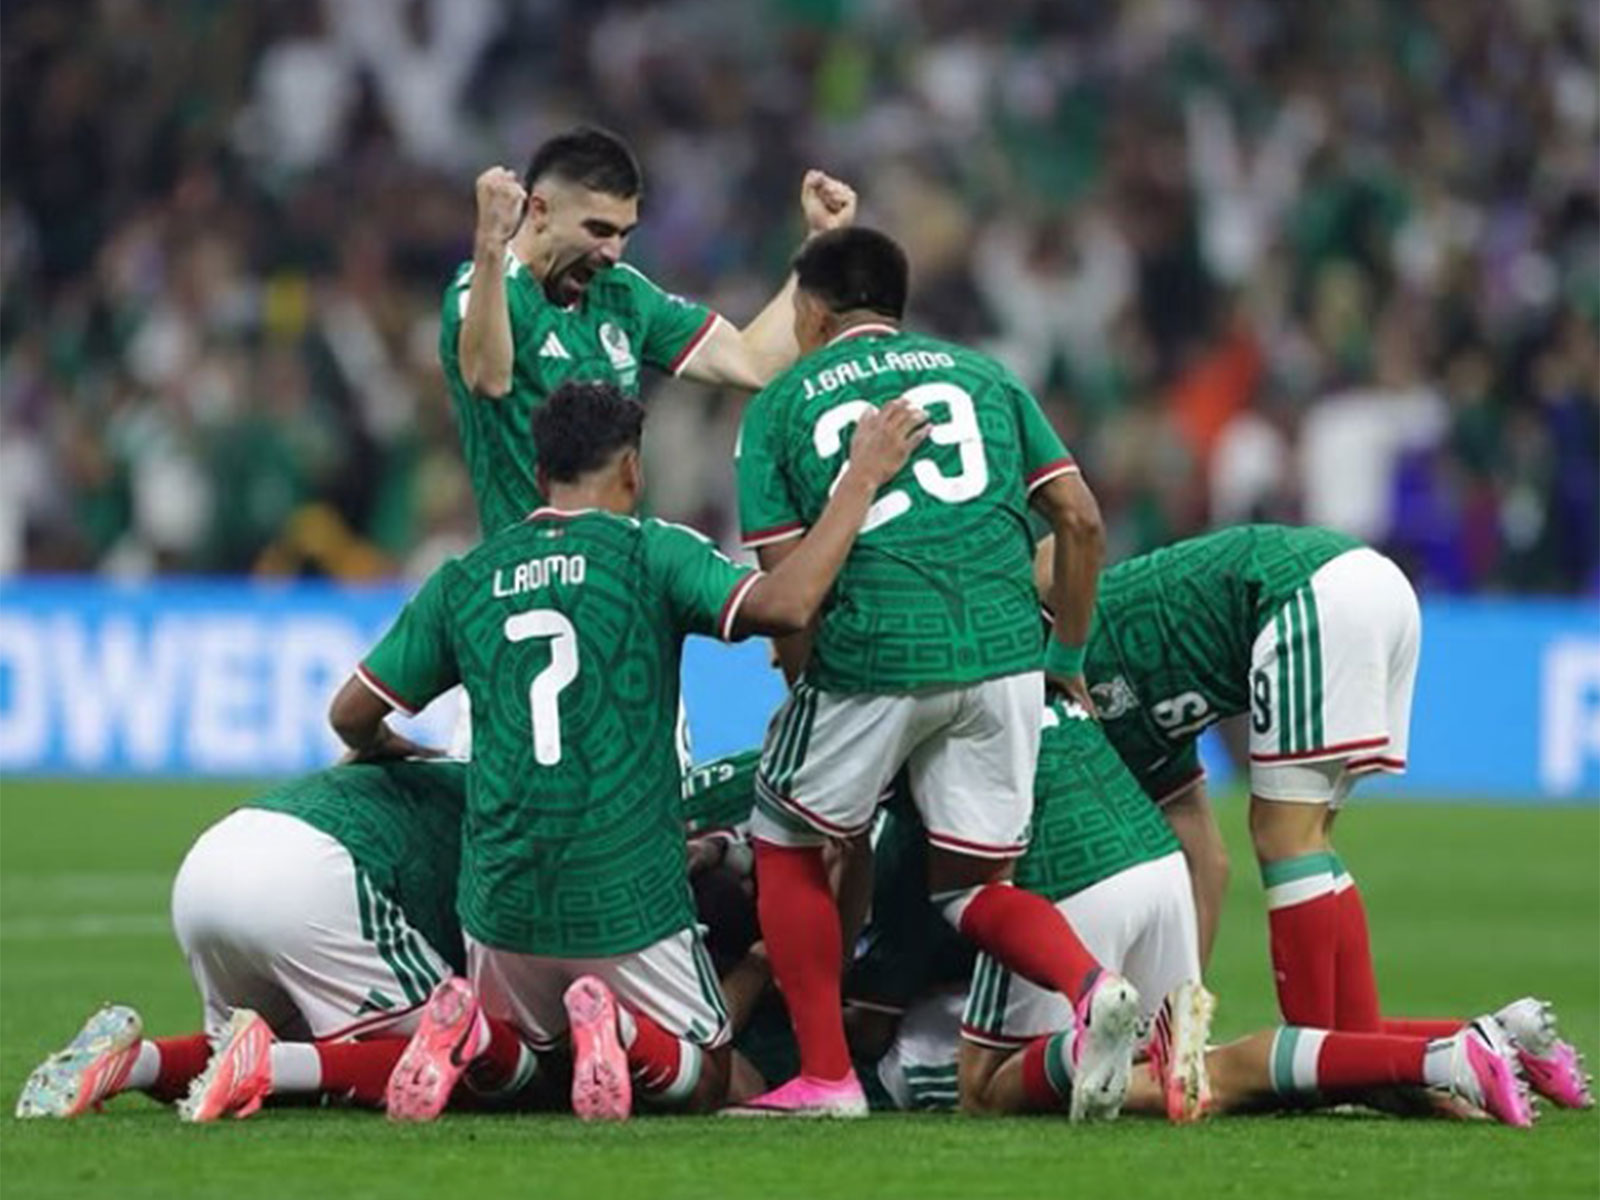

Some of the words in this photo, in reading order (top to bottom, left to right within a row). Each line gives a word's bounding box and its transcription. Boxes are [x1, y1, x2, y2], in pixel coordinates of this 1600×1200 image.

[802, 351, 956, 401] J.GALLARDO
[493, 554, 586, 598] L.ROMO
[504, 608, 580, 767] 7
